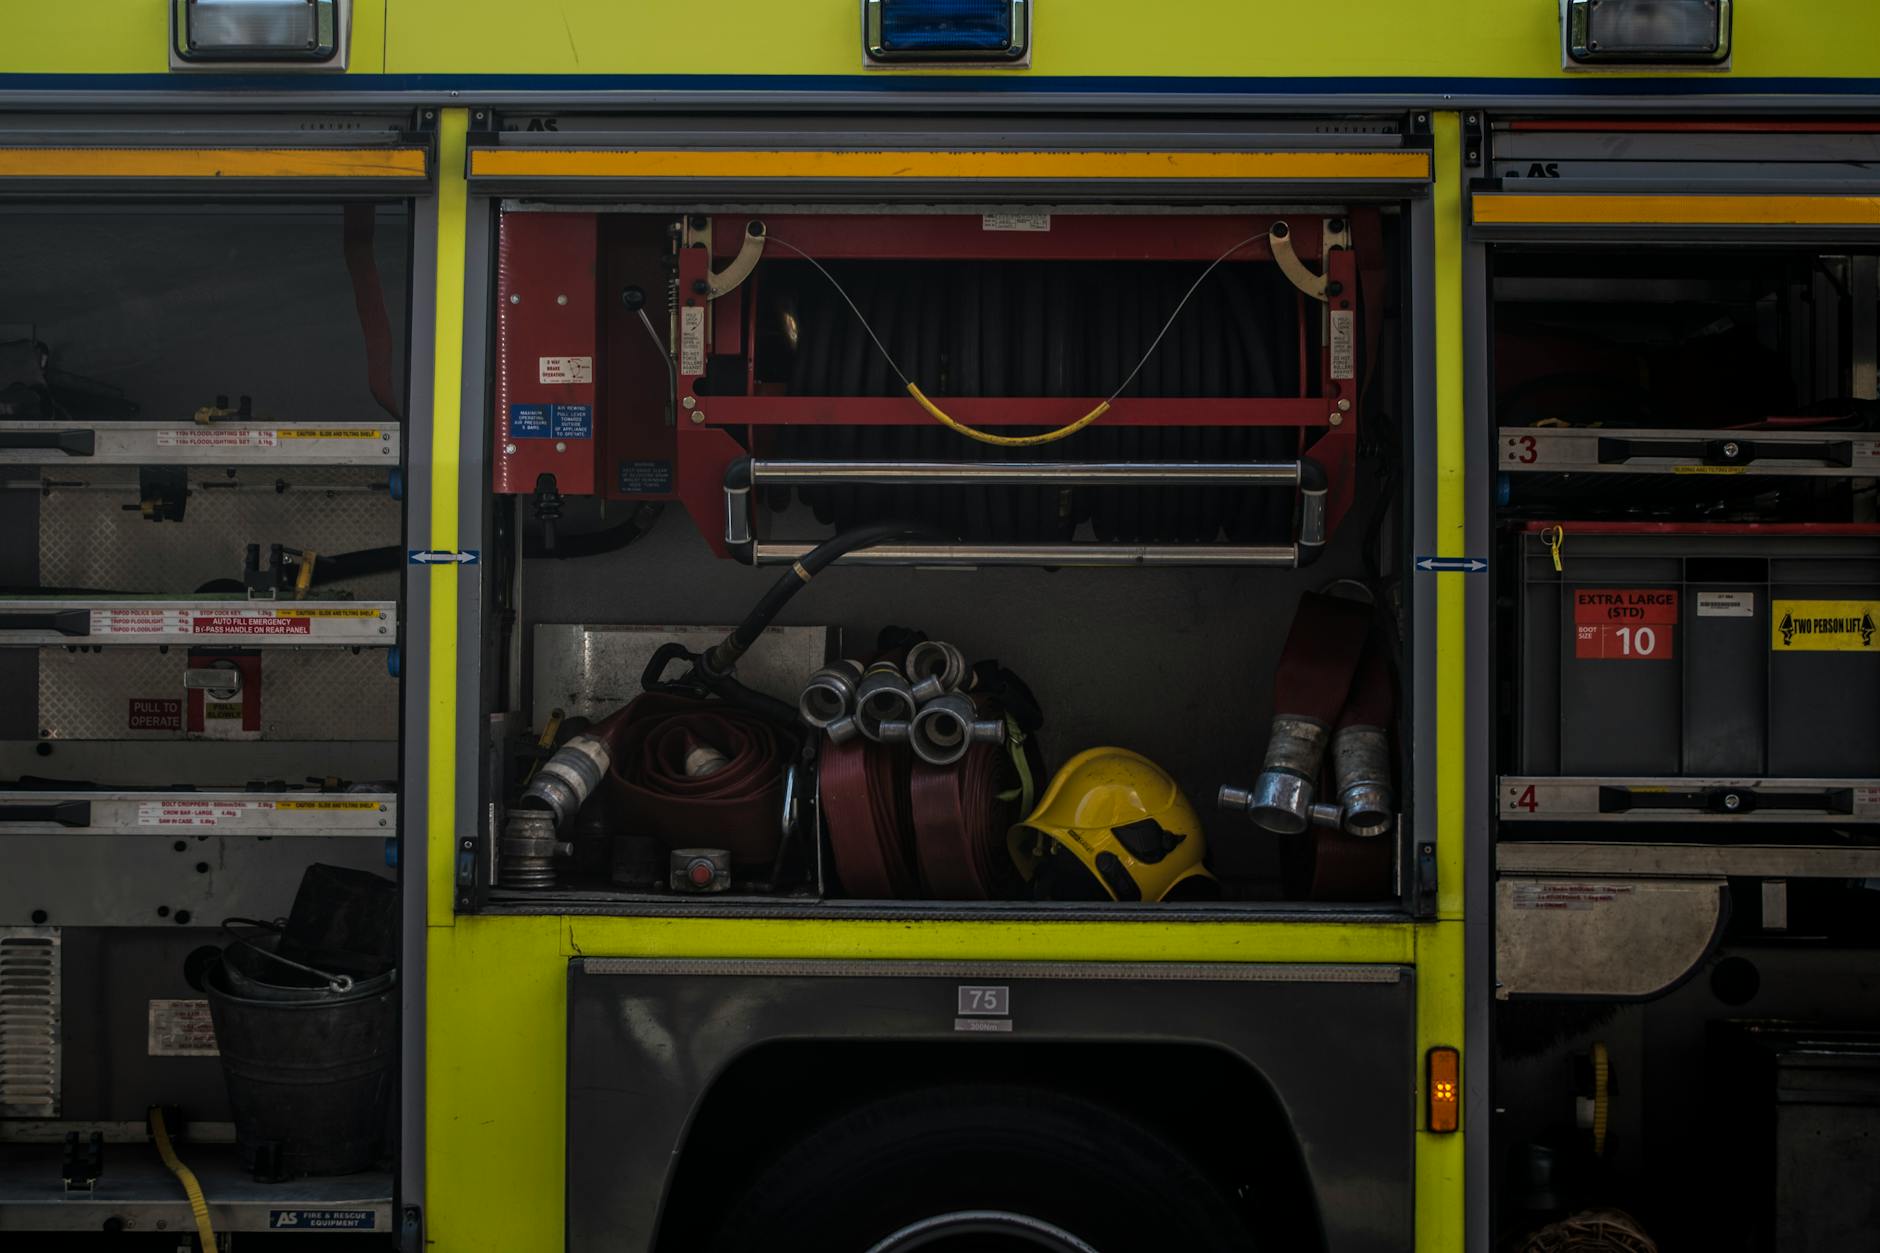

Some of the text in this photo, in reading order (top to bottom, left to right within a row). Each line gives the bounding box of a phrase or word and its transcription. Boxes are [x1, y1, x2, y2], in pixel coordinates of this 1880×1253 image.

[1527, 163, 1560, 177] AS
[1519, 436, 1537, 463] 3
[1579, 594, 1673, 605] EXTRA LARGE
[1608, 607, 1645, 619] (STD)
[213, 618, 291, 626] AUTO FILL EMERGENCY
[1793, 618, 1861, 633] TWO PERSON LIFT
[225, 626, 253, 634] HANDLE
[254, 626, 264, 634] ON
[266, 626, 285, 634] REAR
[286, 626, 308, 634] PANEL
[1615, 626, 1656, 656] 10
[134, 702, 178, 712] PULL TO
[131, 716, 180, 727] OPERATE
[1518, 784, 1538, 813] 4
[969, 990, 997, 1009] 75
[276, 1211, 298, 1227] AS
